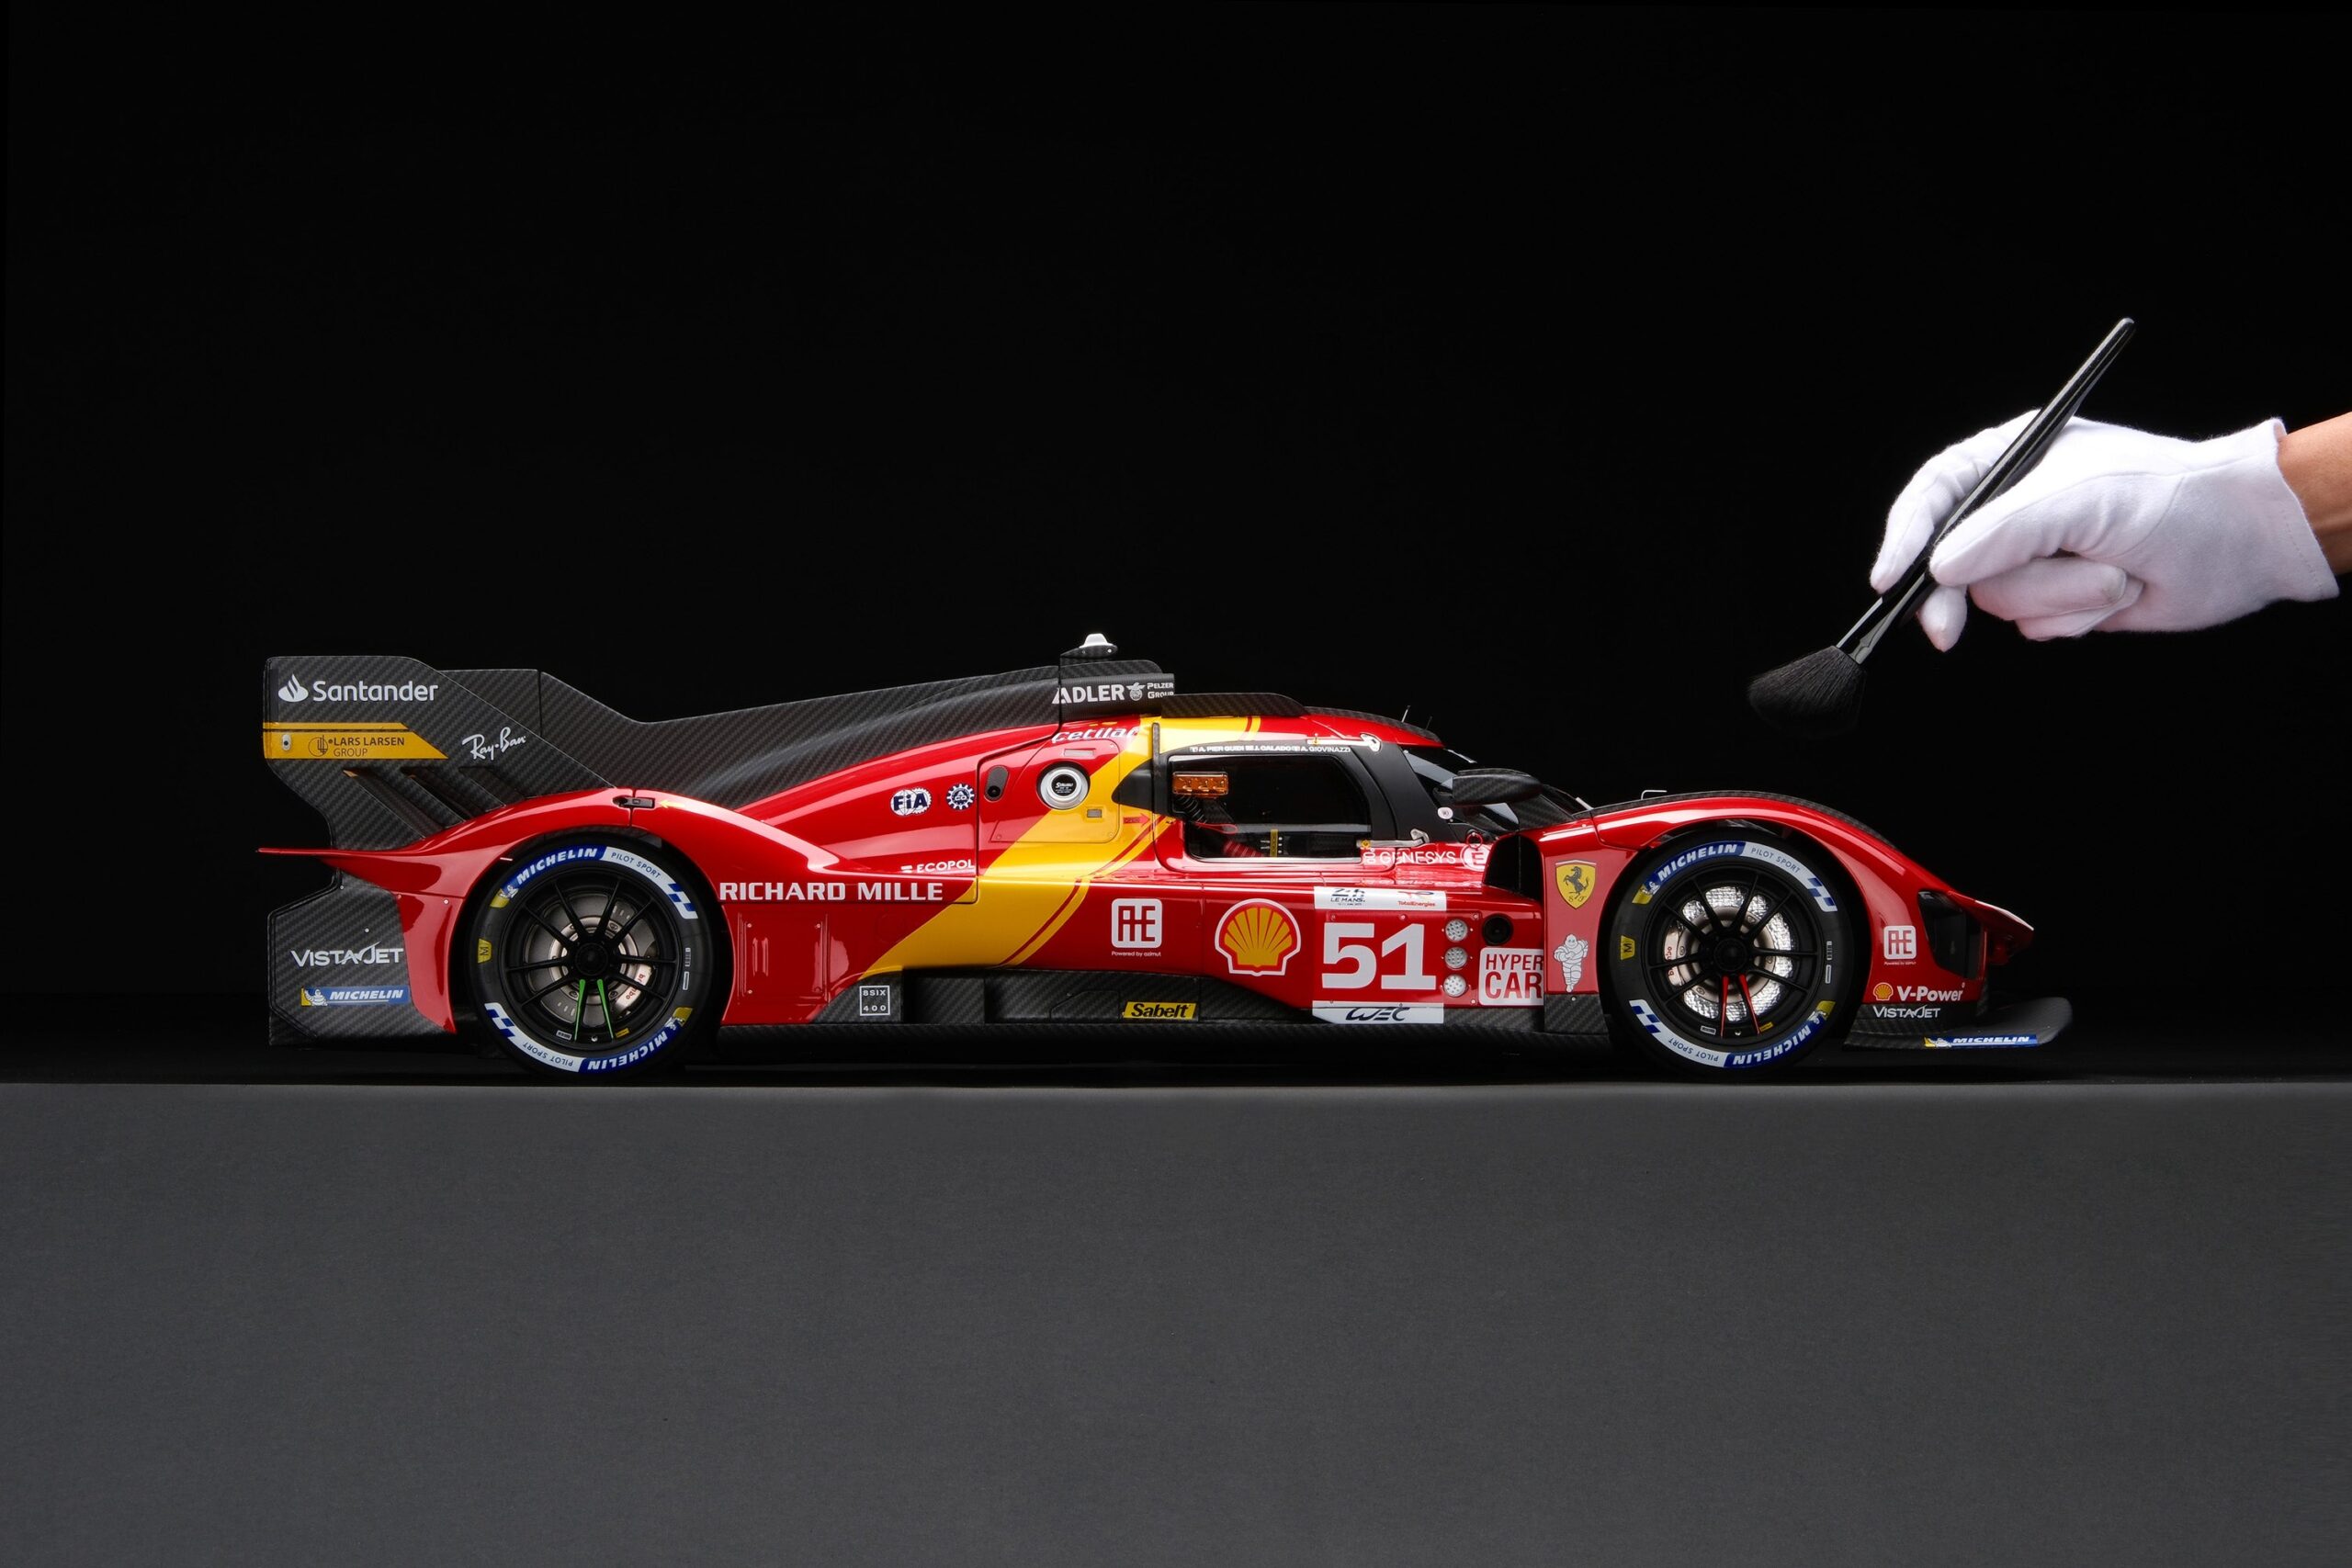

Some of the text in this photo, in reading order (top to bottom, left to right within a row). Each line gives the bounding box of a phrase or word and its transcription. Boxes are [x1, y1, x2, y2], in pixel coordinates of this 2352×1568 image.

[312, 680, 438, 702] Santander
[1051, 683, 1125, 704] ADLER
[334, 737, 405, 746] LARS LARSEN
[334, 748, 368, 757] GROUP
[516, 848, 598, 886] MICHELIN
[611, 852, 662, 879] PILOT SPORT
[916, 858, 976, 873] ECOPOL
[1379, 851, 1457, 864] GENESYS
[1657, 843, 1738, 882] MICHELIN
[1751, 847, 1801, 874] PILOT SPORT
[719, 882, 944, 901] RICHARD MILLE
[1321, 921, 1437, 991] 51
[1486, 953, 1544, 971] HYPER
[329, 989, 404, 1000] MICHELIN
[1485, 971, 1543, 999] CAR
[1896, 986, 1963, 1002] V-Power
[1131, 1002, 1188, 1018] Sabelt
[1344, 1006, 1411, 1021] WEC
[522, 1042, 574, 1068] PILOT SPORT
[587, 1030, 668, 1070] MICHELIN
[1668, 1037, 1719, 1062] PILOT SPORT
[1732, 1026, 1812, 1066] MICHELIN
